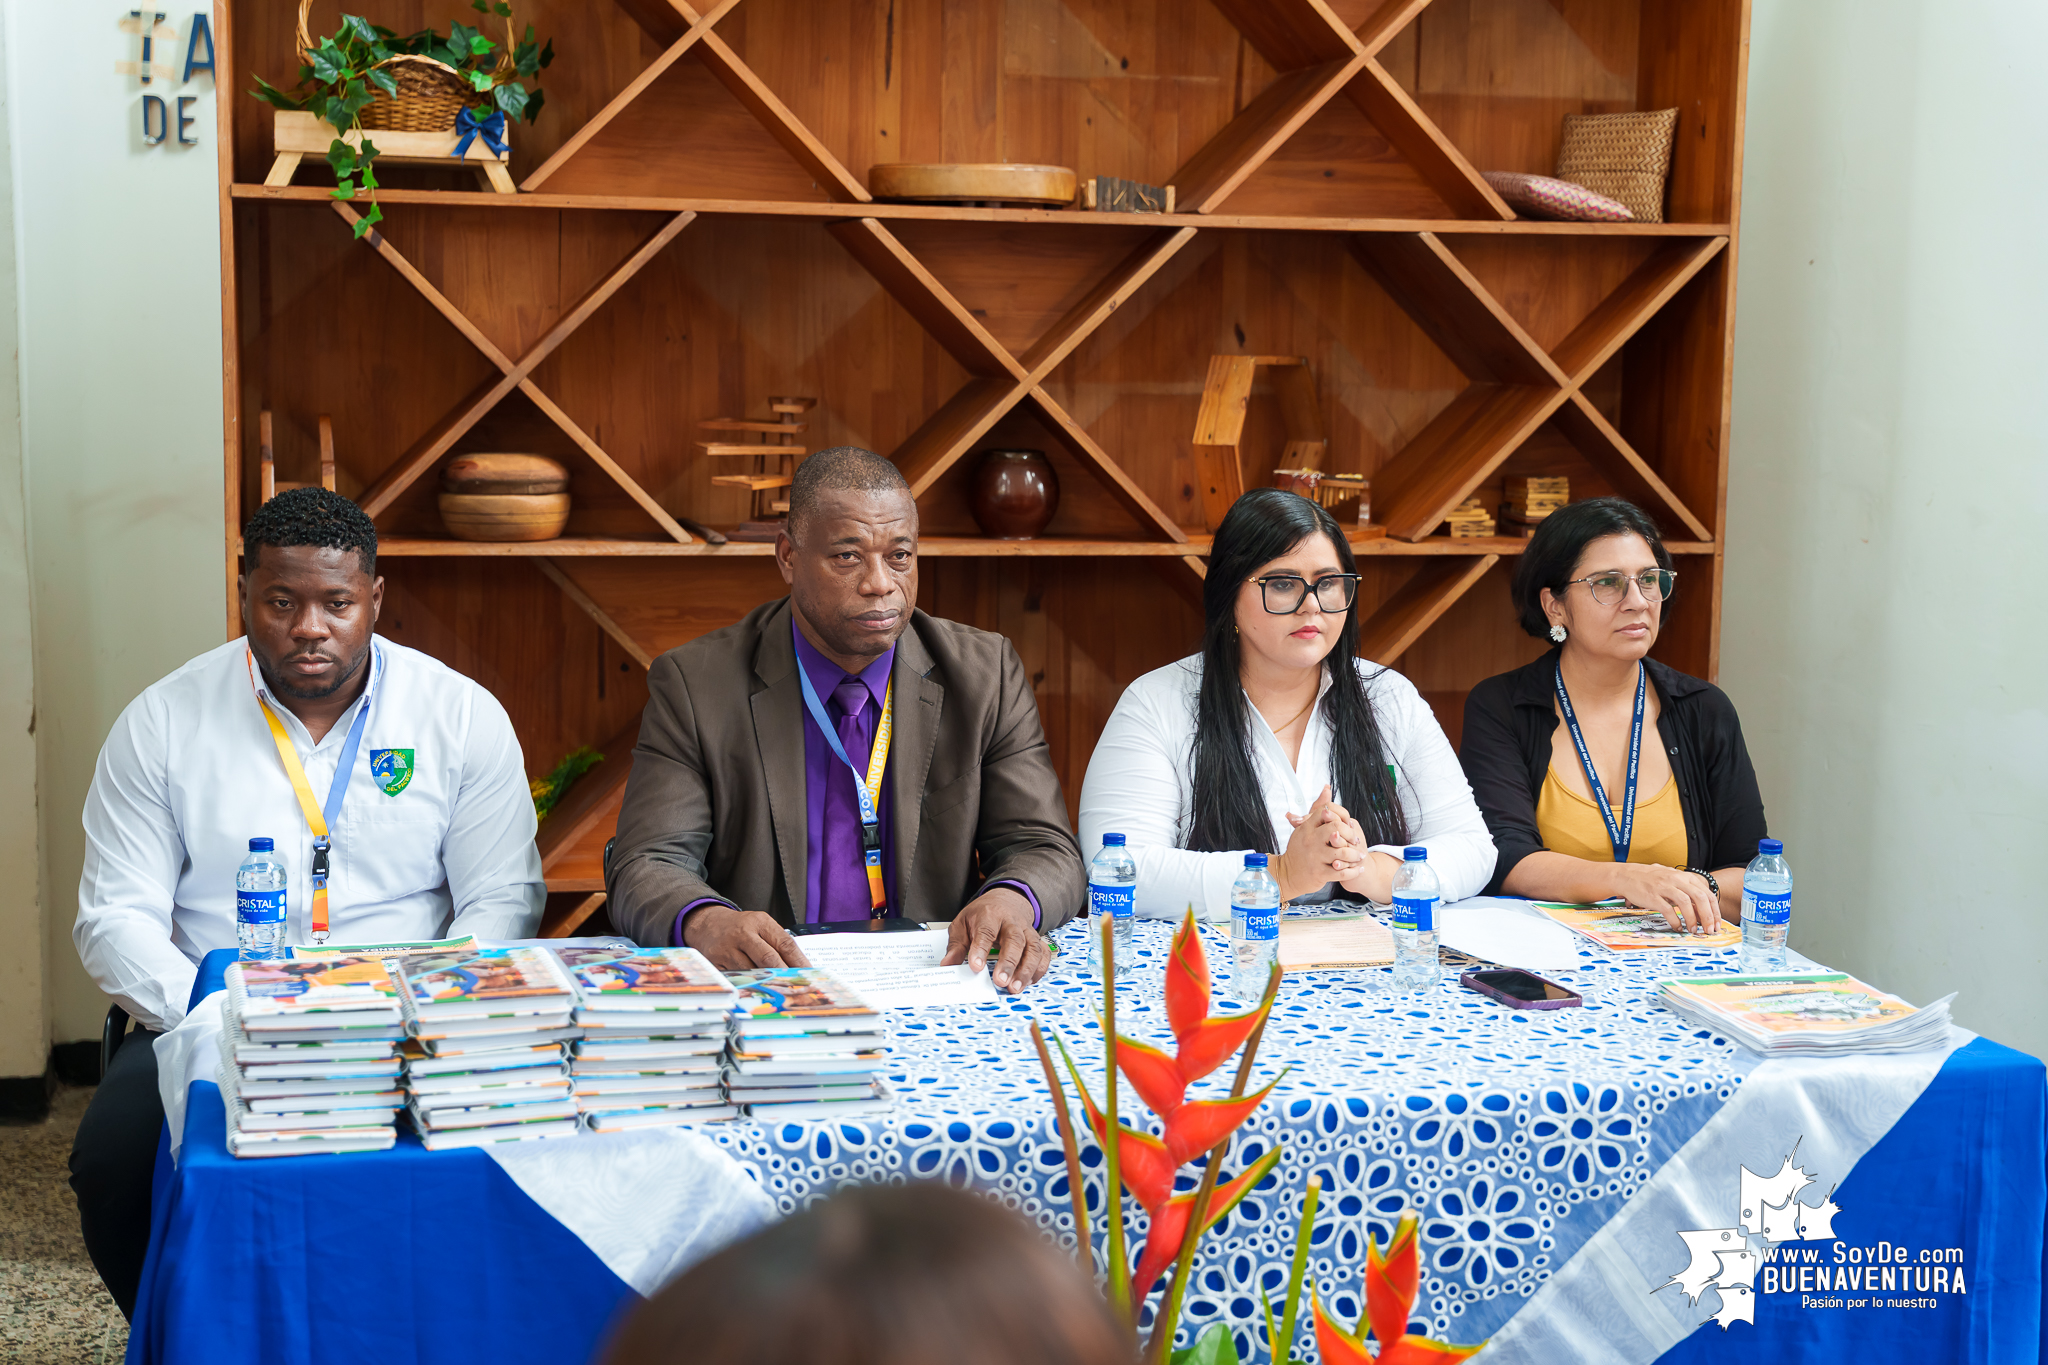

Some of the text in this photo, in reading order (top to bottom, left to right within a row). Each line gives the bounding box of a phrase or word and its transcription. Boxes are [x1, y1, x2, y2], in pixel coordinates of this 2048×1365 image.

[142, 95, 198, 144] DE
[1571, 723, 1586, 753] Universidad
[1632, 722, 1641, 751] Universidad
[866, 713, 893, 798] UNIVERSIDAD
[1596, 786, 1611, 816] Universidad
[1607, 815, 1615, 824] del
[1626, 786, 1635, 816] Universidad
[237, 897, 276, 909] CRISTAL
[1093, 891, 1131, 903] CRISTAL
[1758, 899, 1791, 910] CRISTAL
[1249, 914, 1280, 926] CRISTA
